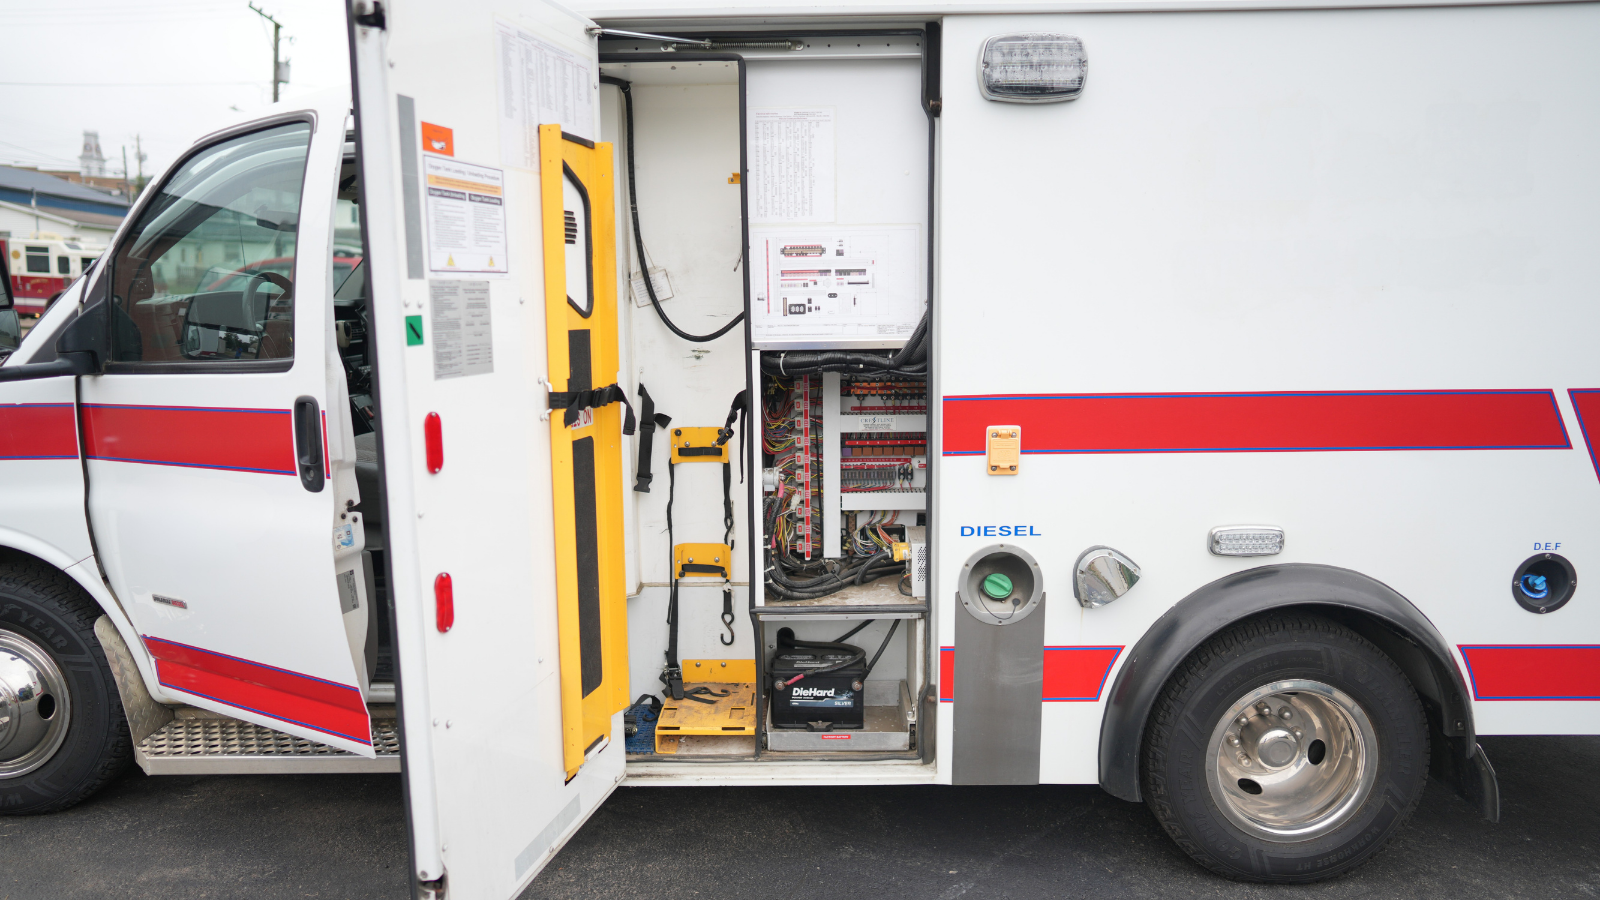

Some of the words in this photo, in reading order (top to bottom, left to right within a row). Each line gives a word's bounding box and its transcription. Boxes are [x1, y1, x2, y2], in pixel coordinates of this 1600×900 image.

[583, 408, 592, 425] ON
[860, 416, 894, 424] CRESTLINE
[960, 525, 1042, 537] DIESEL
[1533, 542, 1562, 551] D.E.F
[792, 687, 836, 697] DieHard
